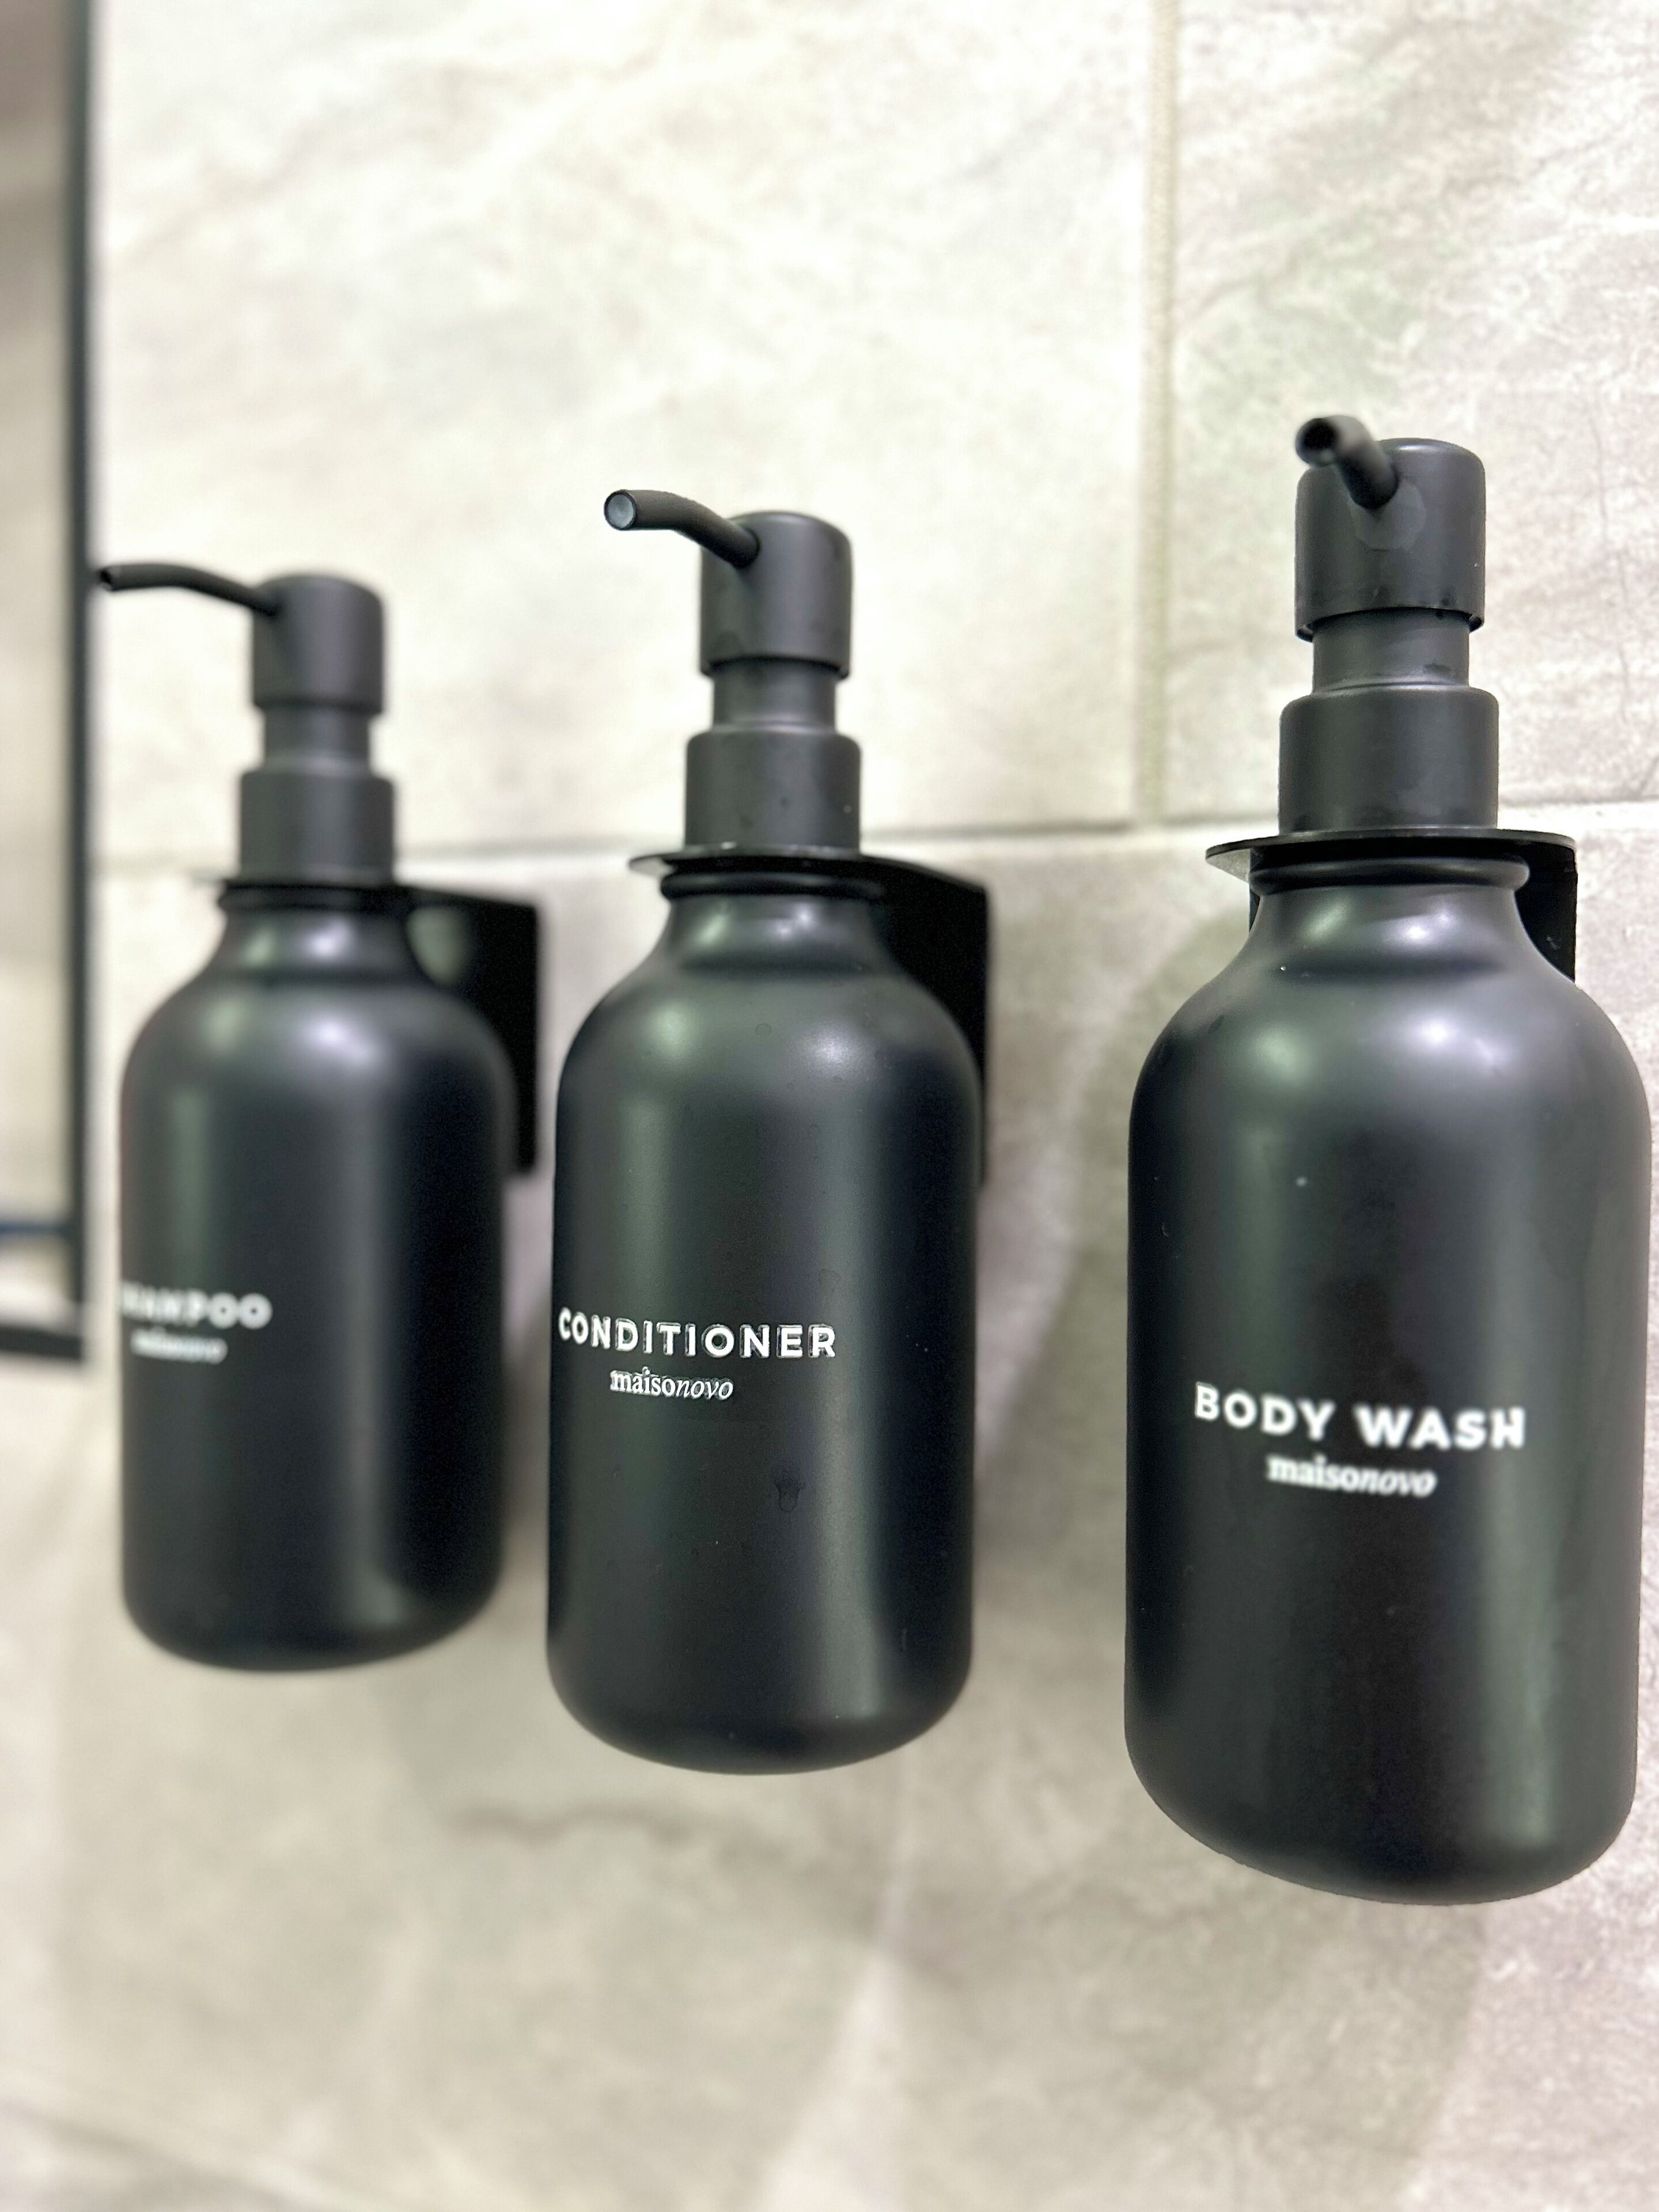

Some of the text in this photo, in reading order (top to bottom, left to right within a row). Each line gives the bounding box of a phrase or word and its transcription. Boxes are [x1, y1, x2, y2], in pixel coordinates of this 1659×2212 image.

[558, 1306, 836, 1358] CONDITIONER
[609, 1366, 734, 1400] maisonovo
[1195, 1381, 1526, 1450] BODY WASH
[1266, 1454, 1438, 1498] maisonovo
